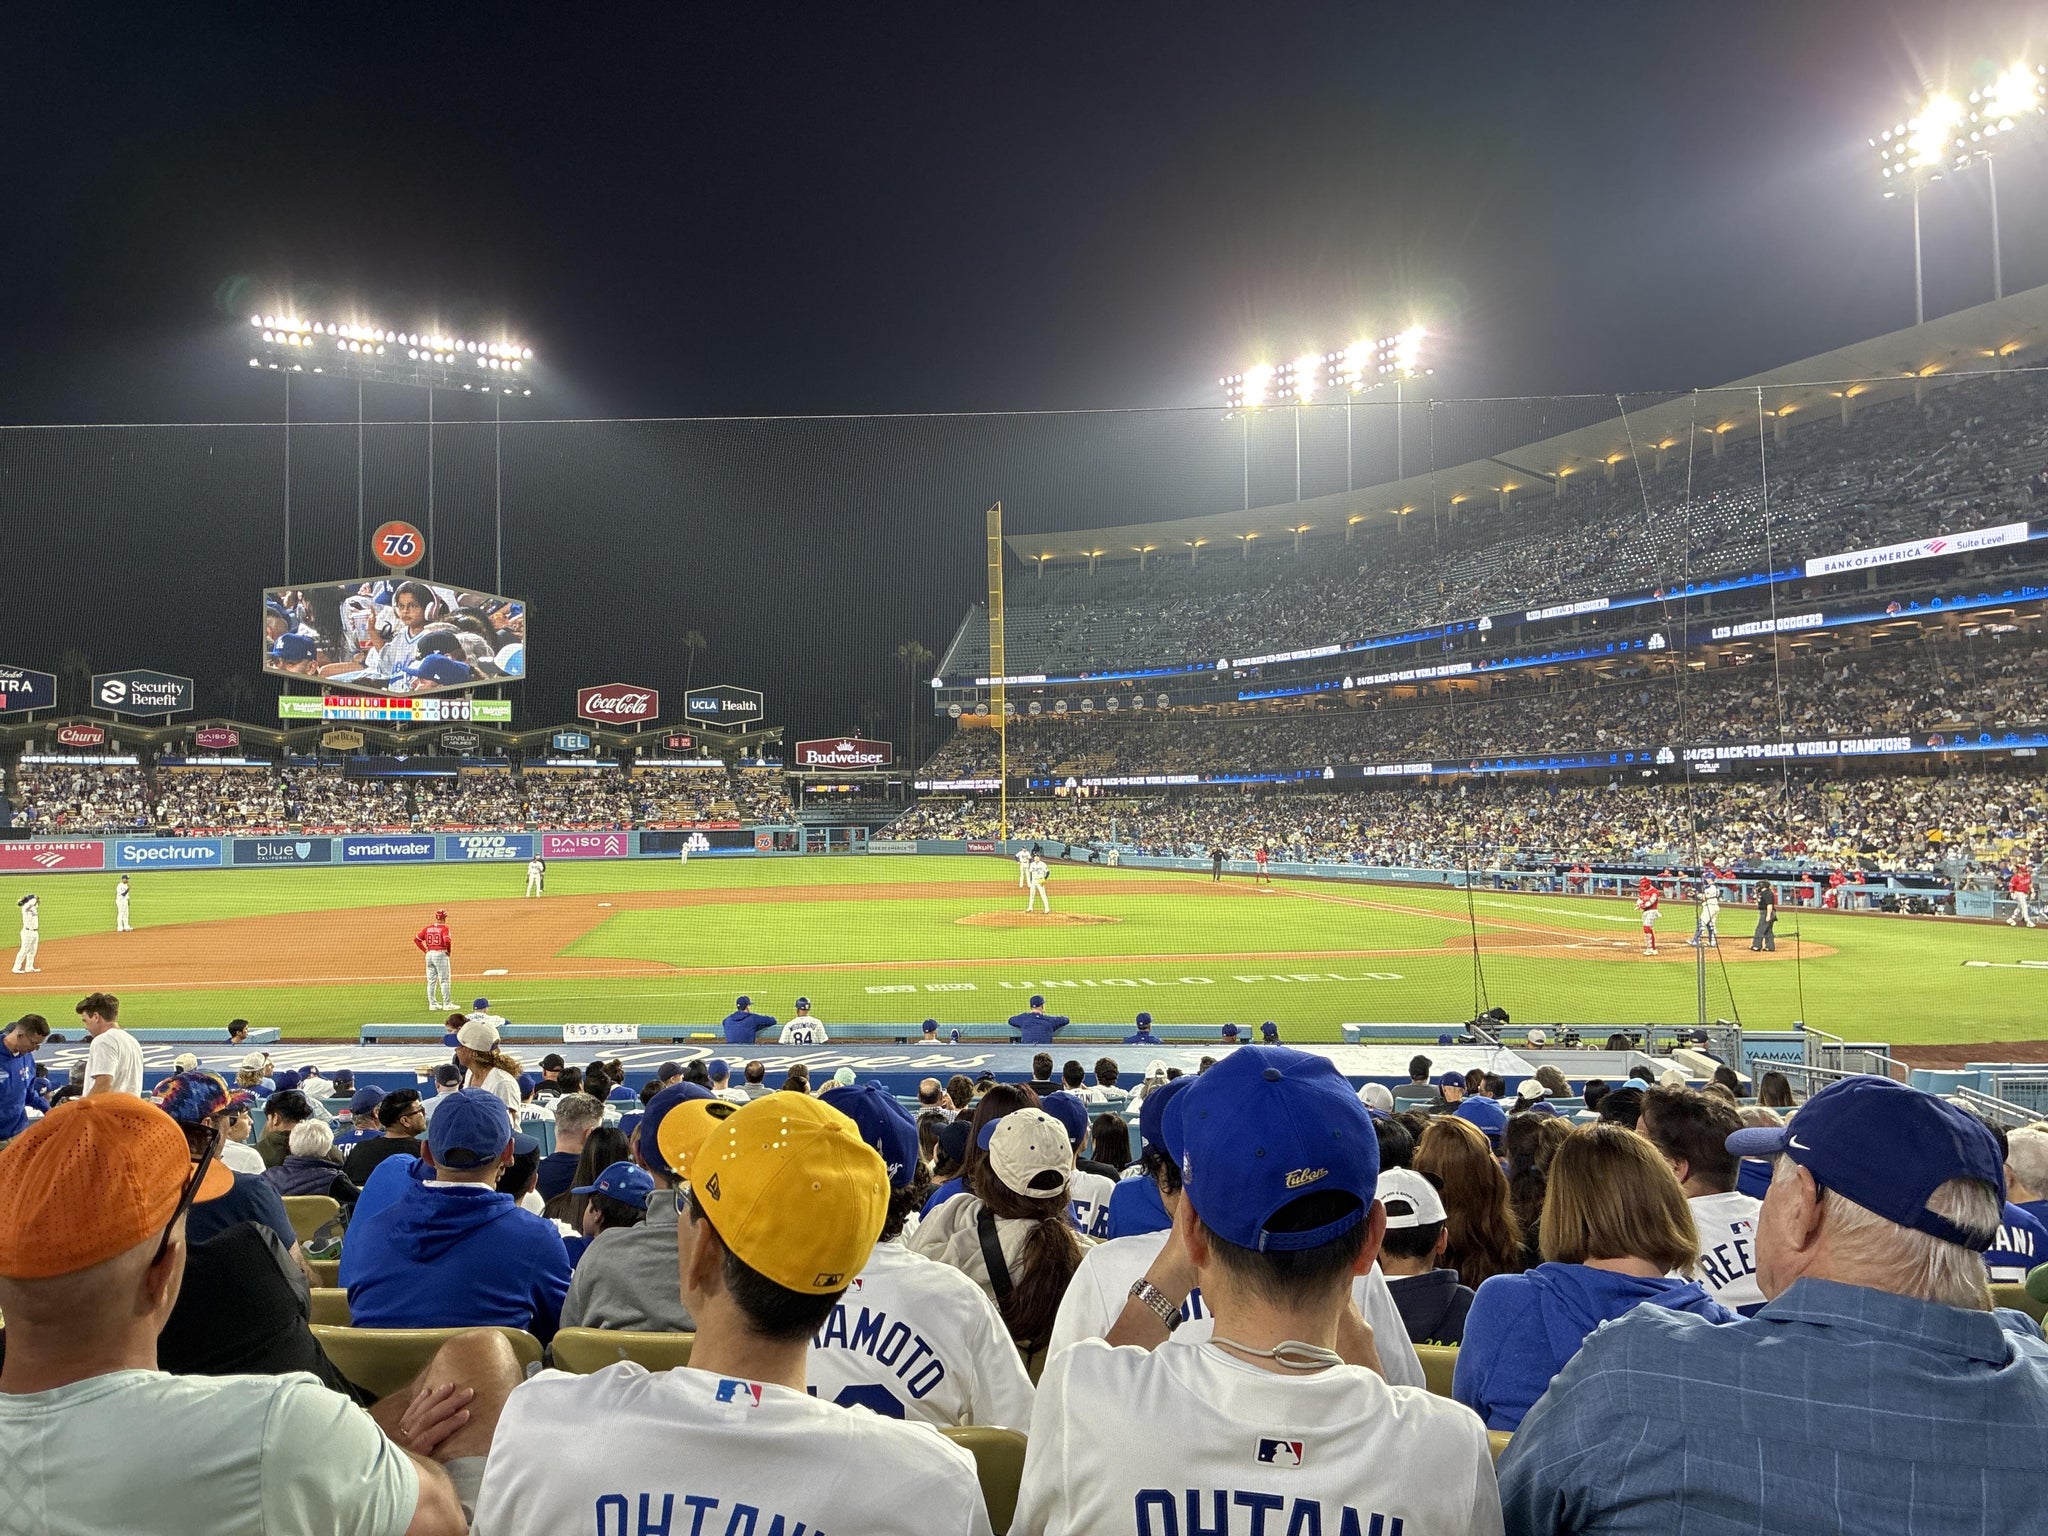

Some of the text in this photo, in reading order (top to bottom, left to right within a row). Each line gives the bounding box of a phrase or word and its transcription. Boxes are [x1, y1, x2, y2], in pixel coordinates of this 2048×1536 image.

[383, 533, 415, 556] 76
[1957, 534, 2004, 550] Suite Level
[1825, 548, 1920, 571] BANK OF AMERICA
[1712, 613, 1823, 639] LOS ANGELES DODGERS
[132, 681, 184, 695] Security
[132, 694, 176, 706] Benefit
[586, 693, 650, 714] Coca-Cola
[692, 701, 756, 711] UCLA Health
[442, 707, 449, 719] 0
[452, 707, 459, 719] 0
[462, 707, 469, 719] 0
[60, 730, 101, 742] Churu
[327, 732, 360, 746] JIM BEAM
[558, 736, 586, 748] TEL
[1683, 737, 1911, 760] 24/25 BACK-TO-BACK WORLD CHAMPIONS
[459, 837, 506, 847] TOYO
[552, 838, 600, 847] DAISO
[124, 845, 209, 863] Spectrum
[258, 843, 293, 856] blue
[348, 843, 430, 856] smartwater
[466, 847, 517, 858] TIRES
[998, 972, 1404, 989] UNIQLO FIELD
[794, 1030, 812, 1045] 84
[812, 1304, 944, 1399] AMOTO
